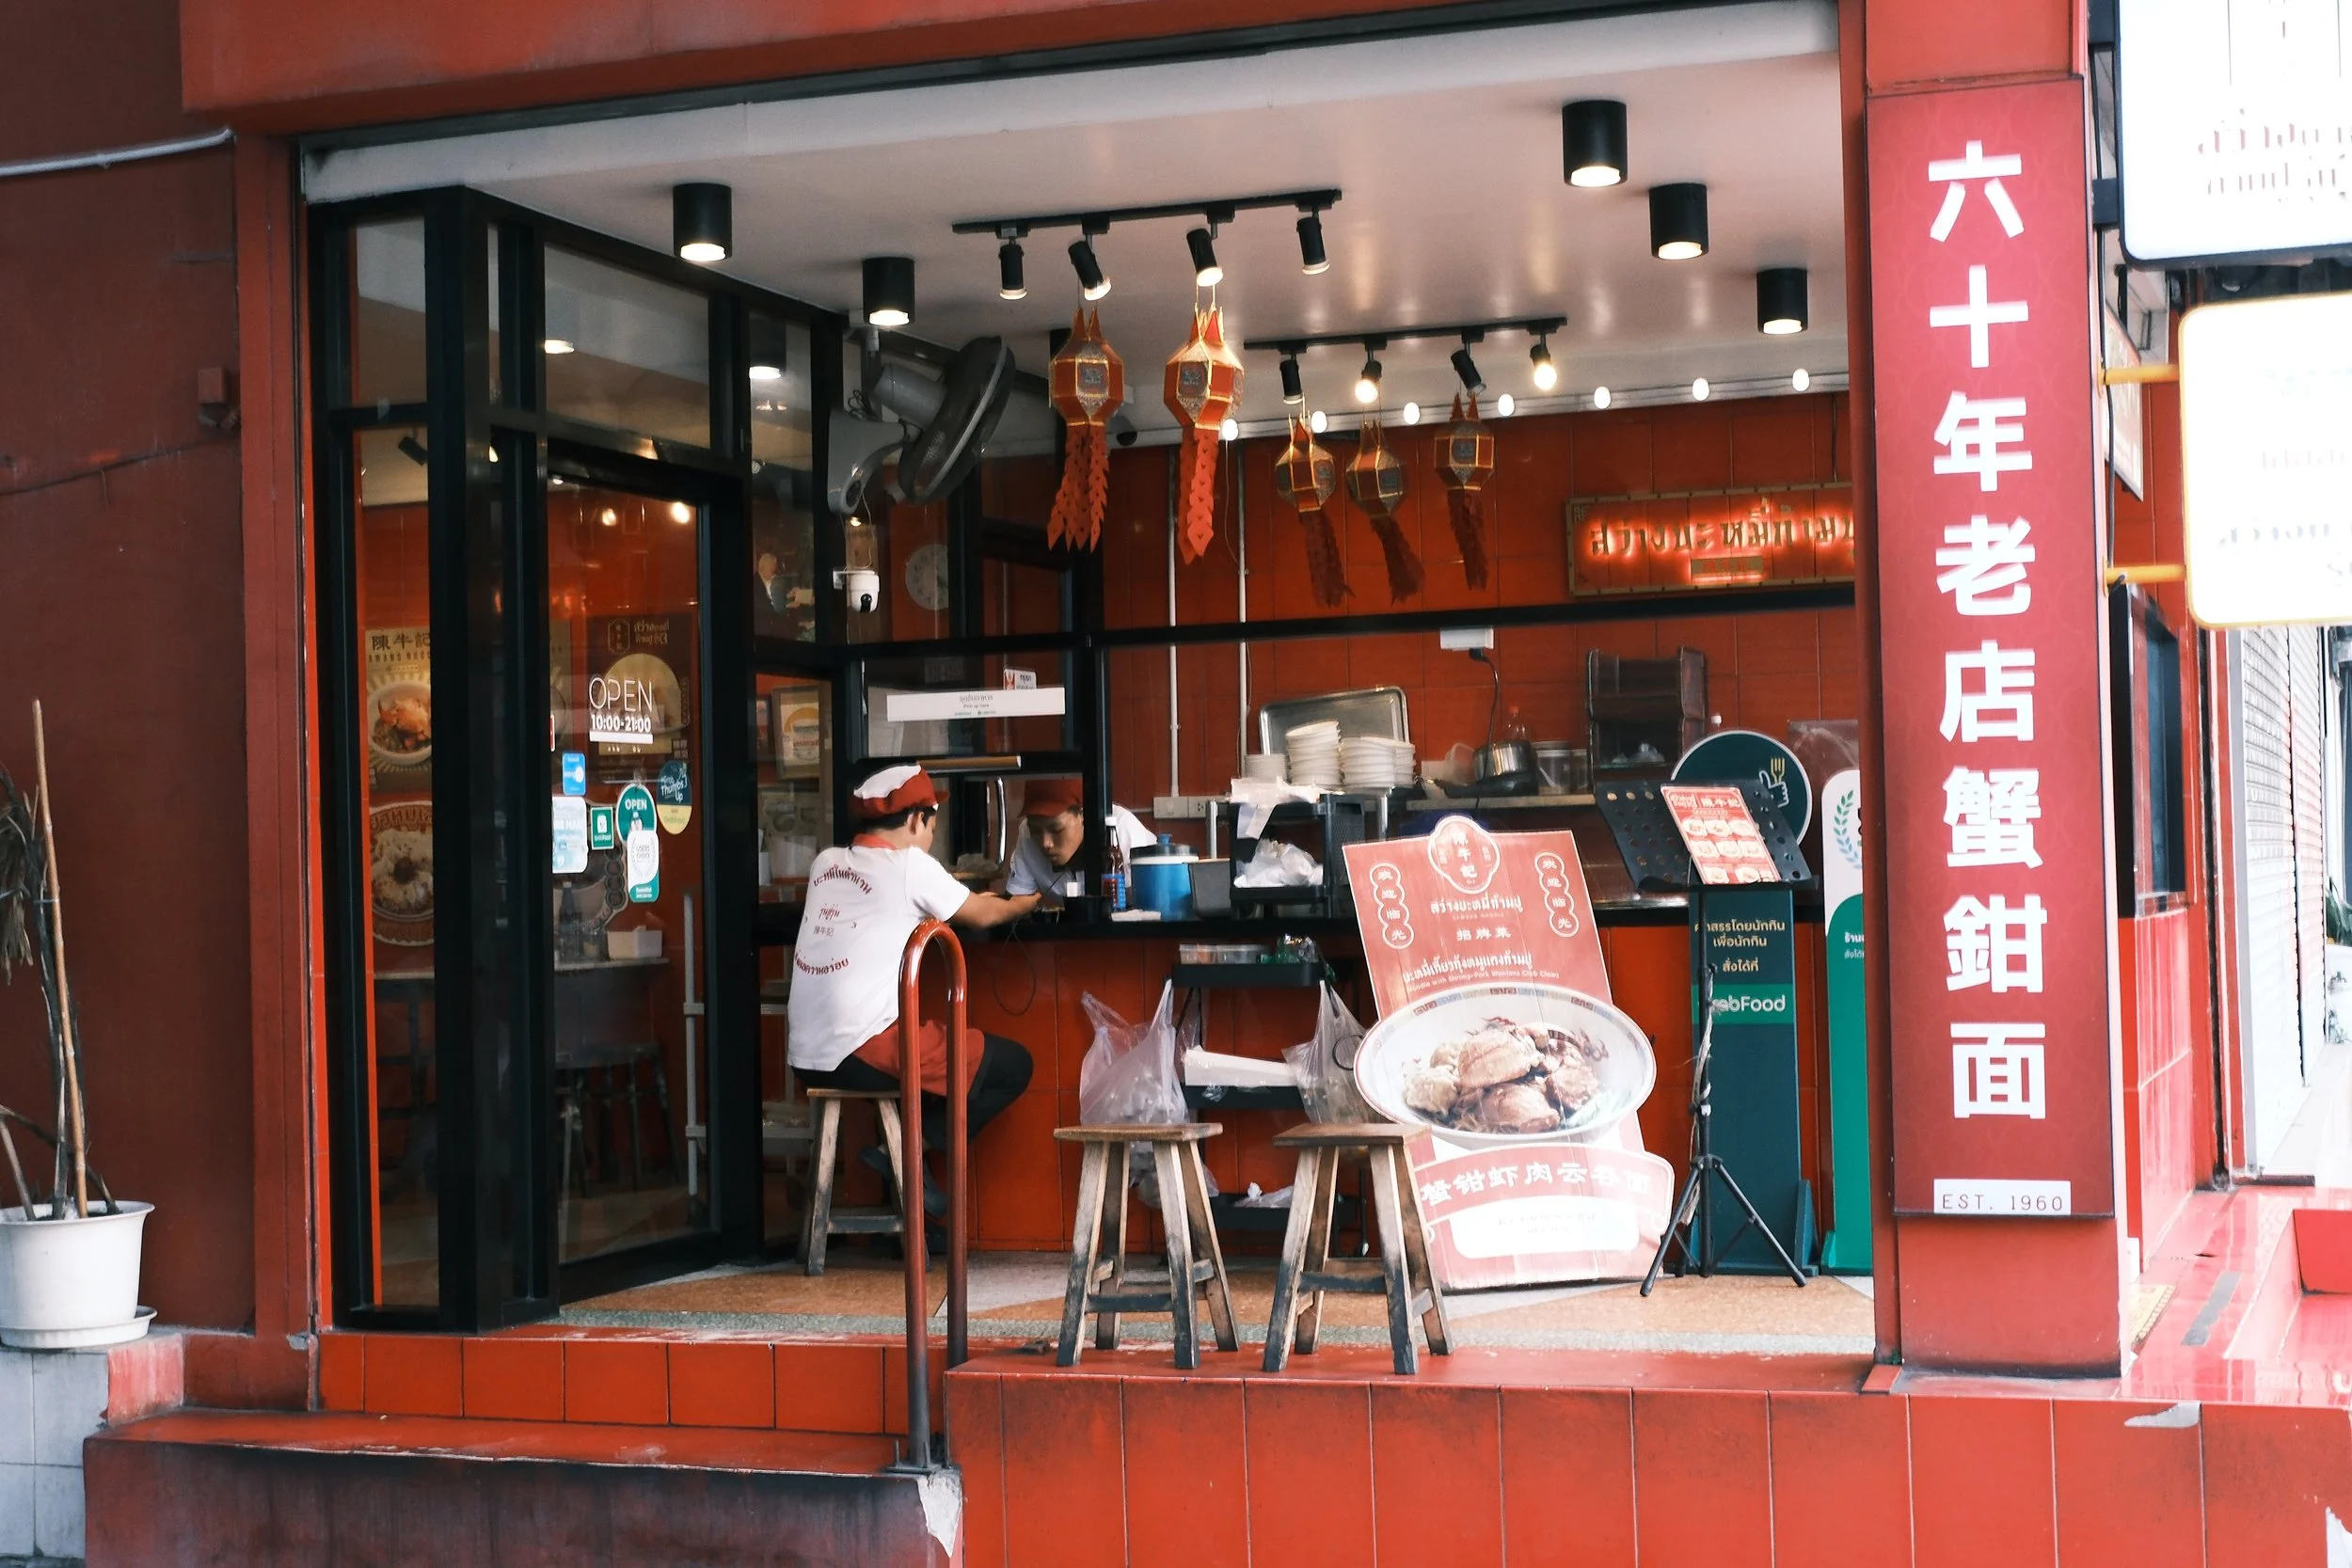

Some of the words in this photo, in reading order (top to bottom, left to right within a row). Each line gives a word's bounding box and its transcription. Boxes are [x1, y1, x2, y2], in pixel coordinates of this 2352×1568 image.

[589, 677, 653, 712] OPEN
[625, 800, 647, 811] OPEN
[1713, 932, 1768, 947] เพื่อนักกิน
[1722, 956, 1759, 973] สั่งได้ที่
[1942, 1193, 1994, 1211] EST.
[2010, 1194, 2063, 1212] 1960
